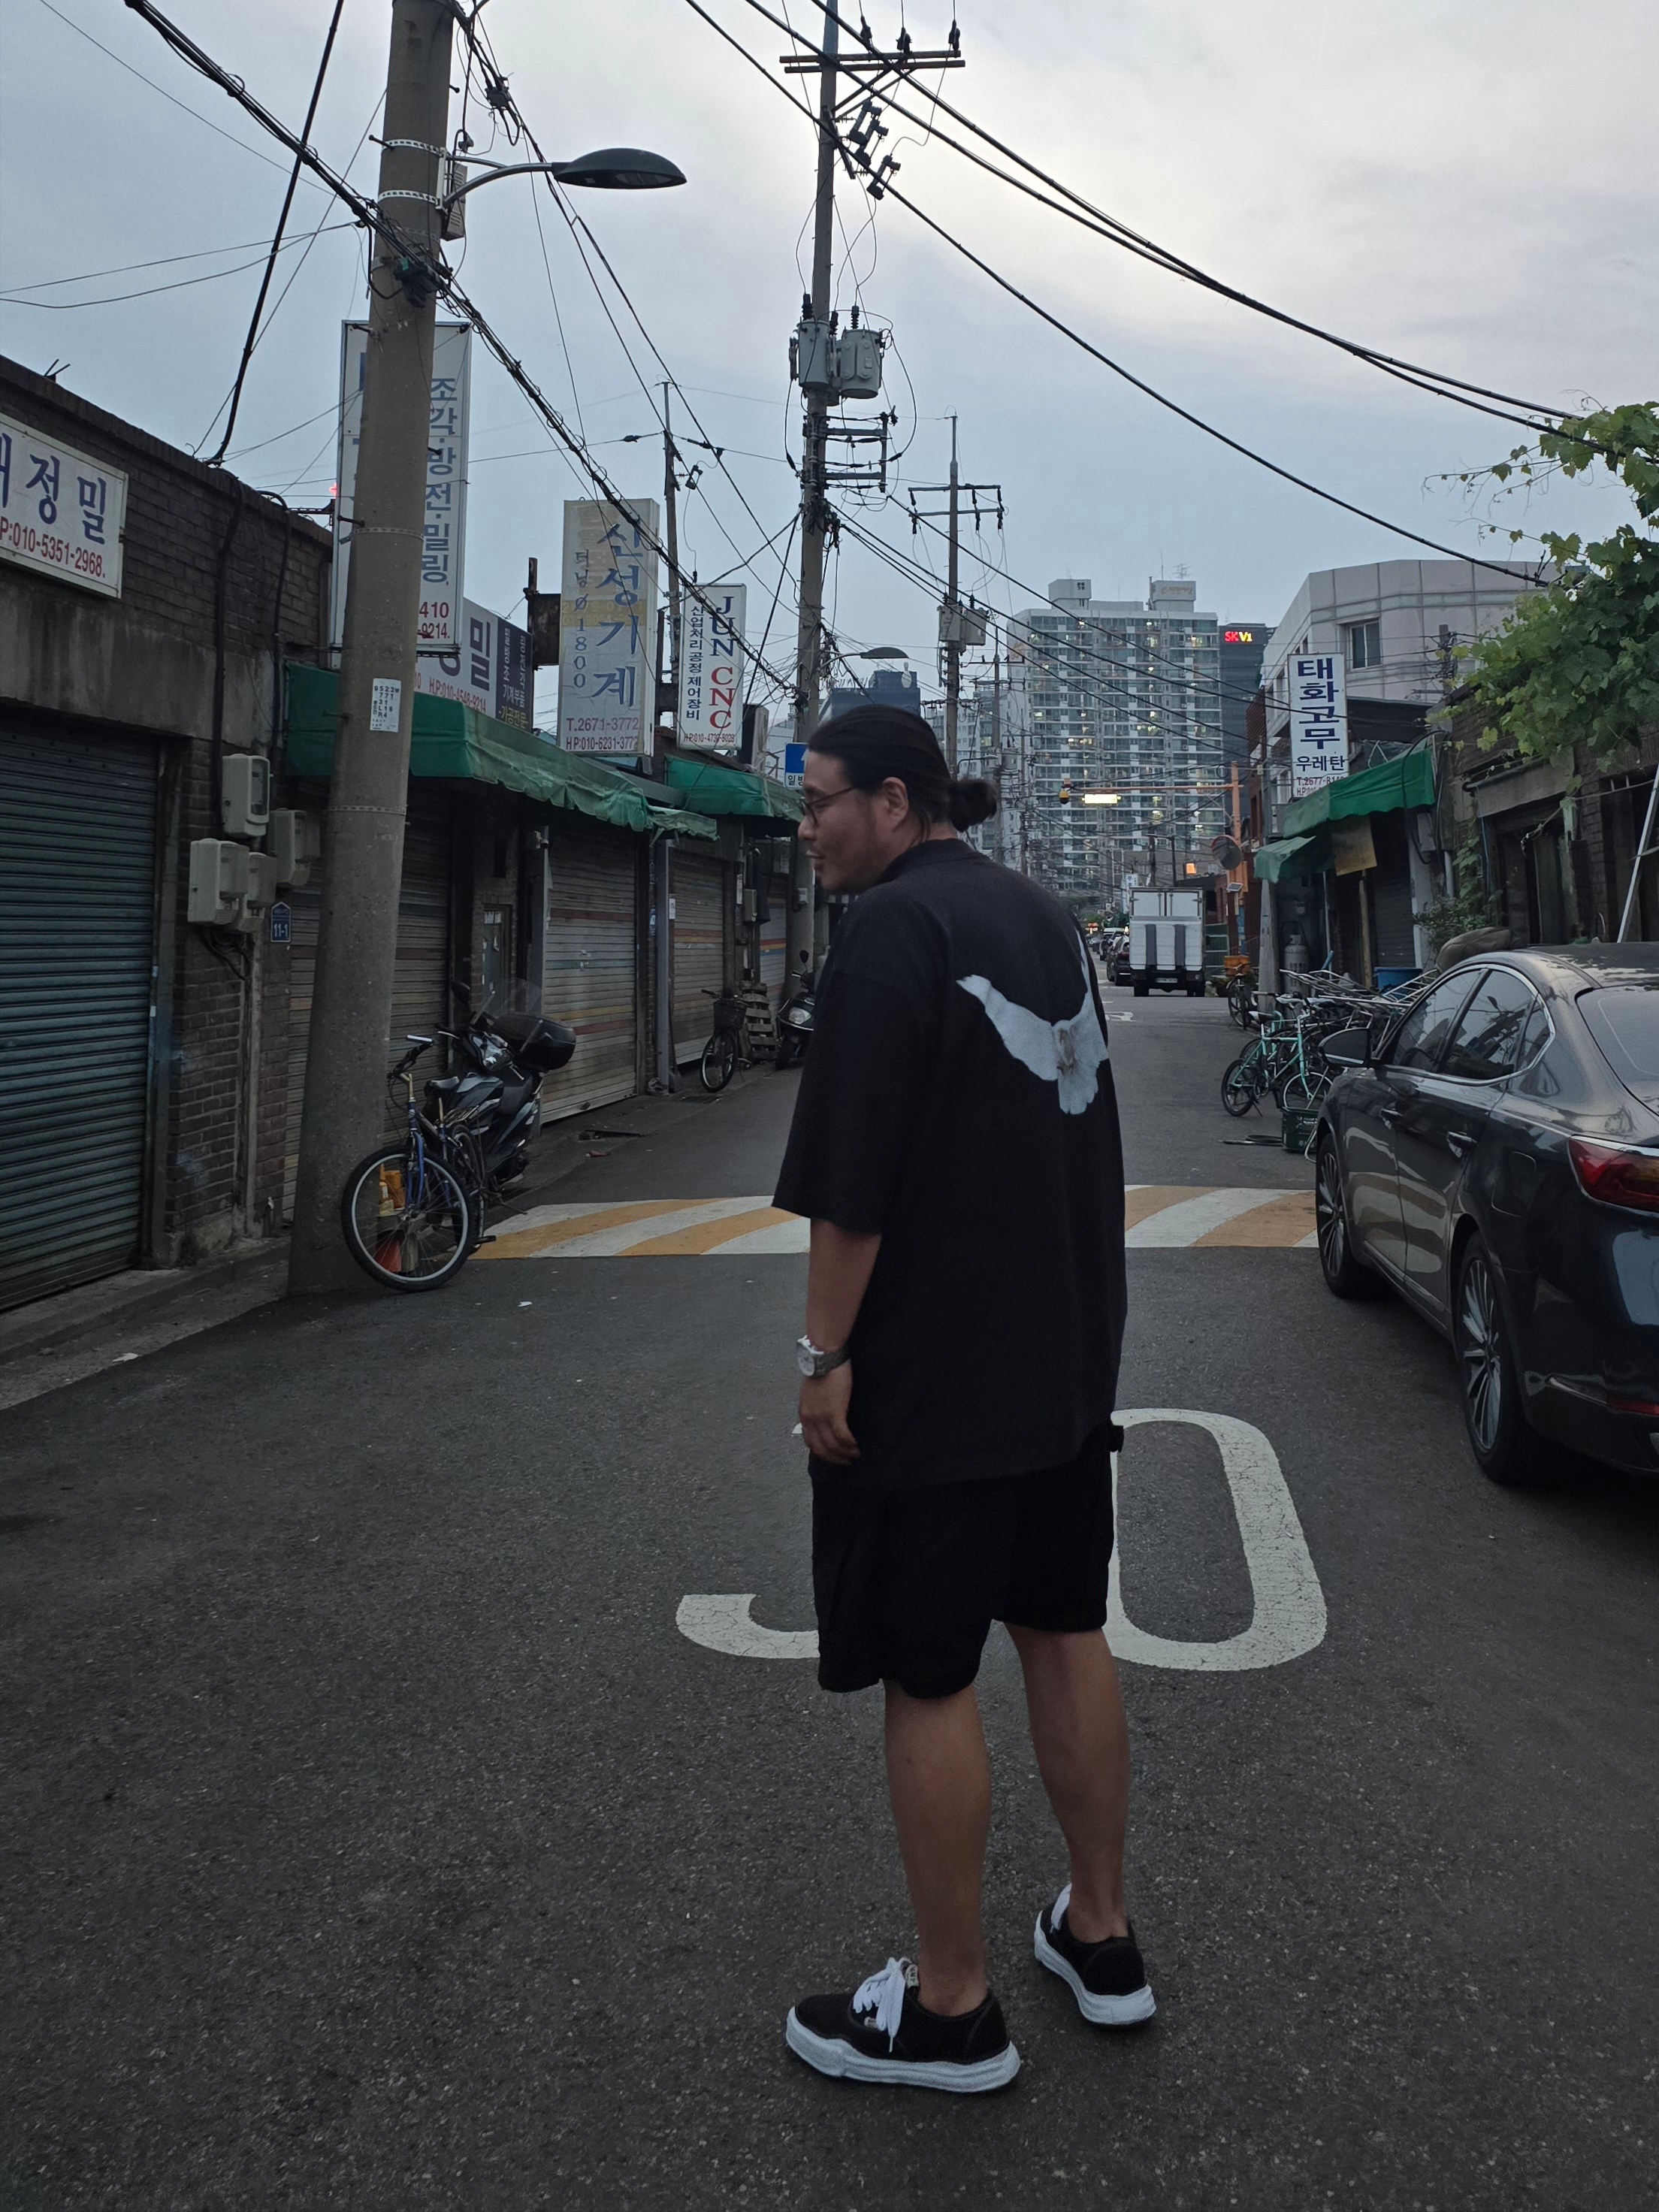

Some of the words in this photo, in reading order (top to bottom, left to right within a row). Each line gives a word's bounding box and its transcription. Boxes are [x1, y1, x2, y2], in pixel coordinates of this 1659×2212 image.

[709, 596, 736, 657] JUN
[1225, 631, 1239, 642] SK
[709, 666, 736, 729] CNC
[1297, 657, 1340, 750] 태화고무
[1296, 756, 1345, 772] 우레탄
[273, 923, 289, 937] 11-1
